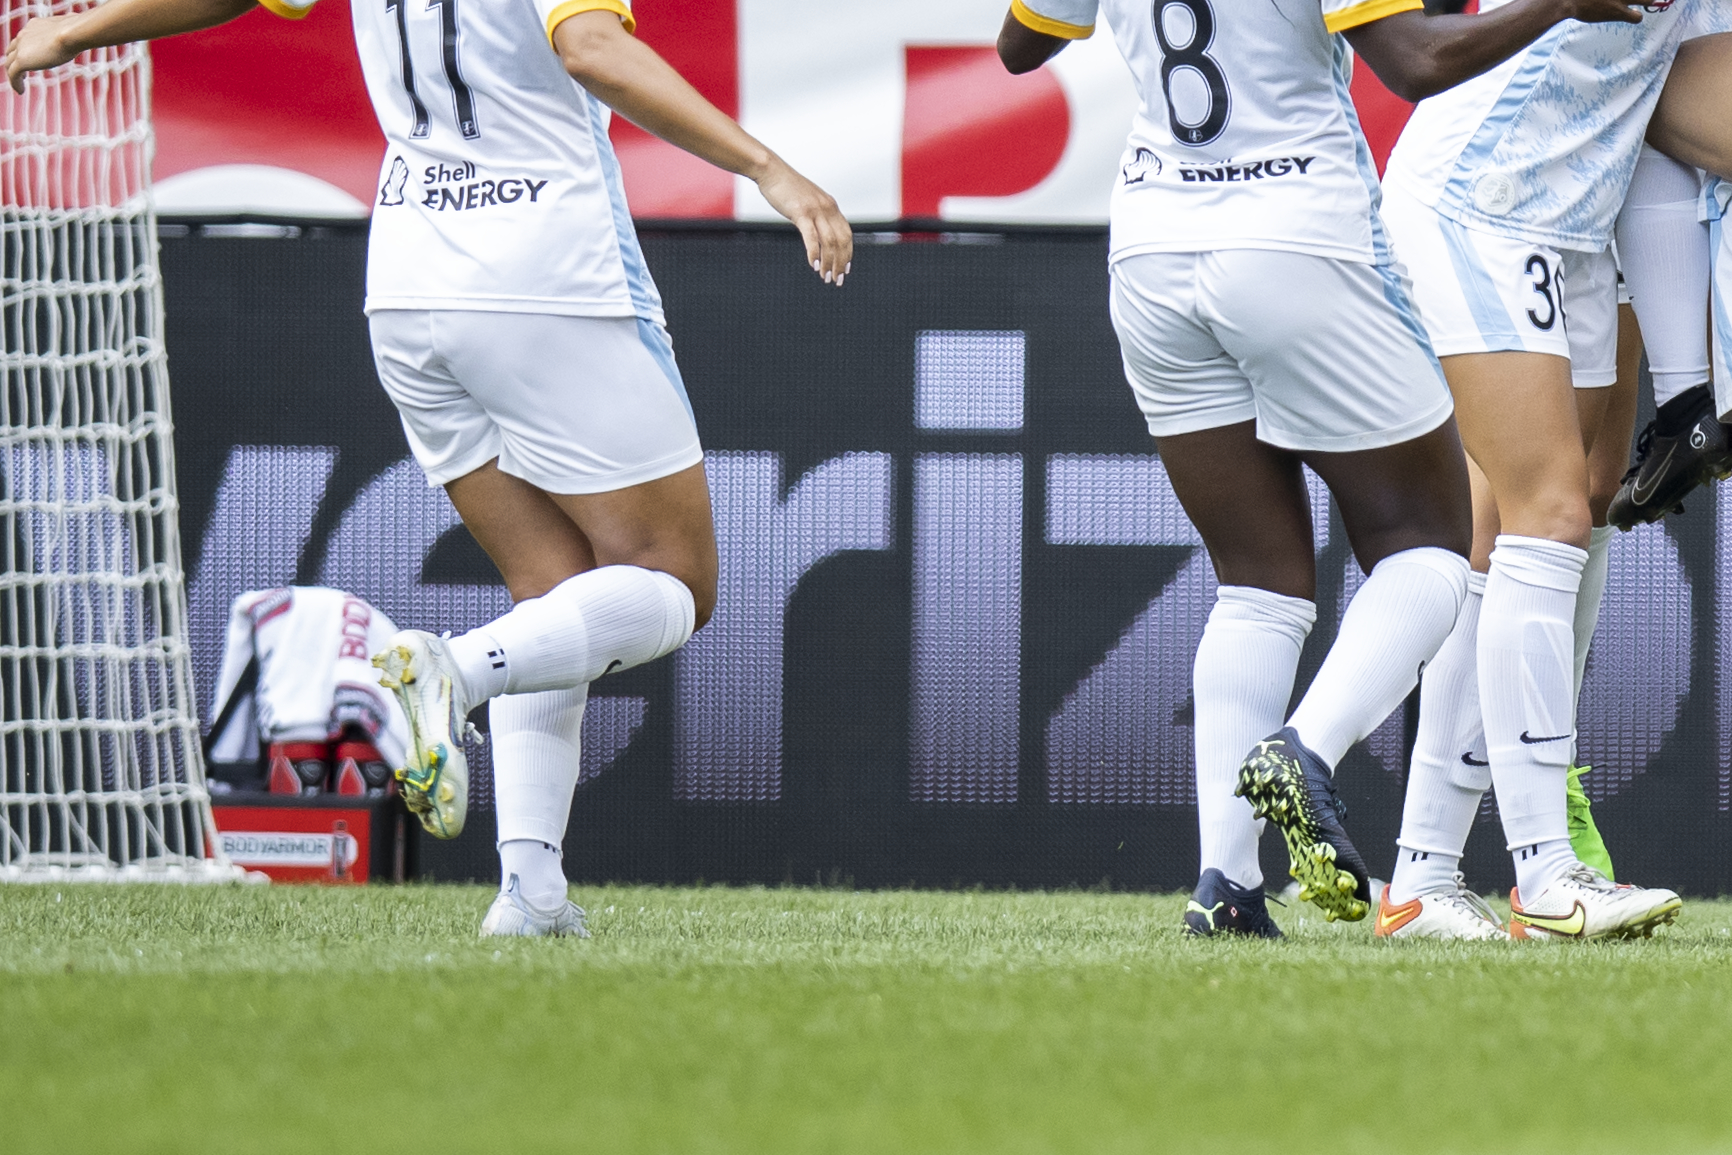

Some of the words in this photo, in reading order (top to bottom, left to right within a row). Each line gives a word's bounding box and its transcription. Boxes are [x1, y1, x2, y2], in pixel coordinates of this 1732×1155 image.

[424, 160, 475, 184] Shell
[1178, 156, 1317, 183] ENERGY
[421, 178, 548, 212] ENERGY
[222, 836, 329, 855] BODYARMOR
